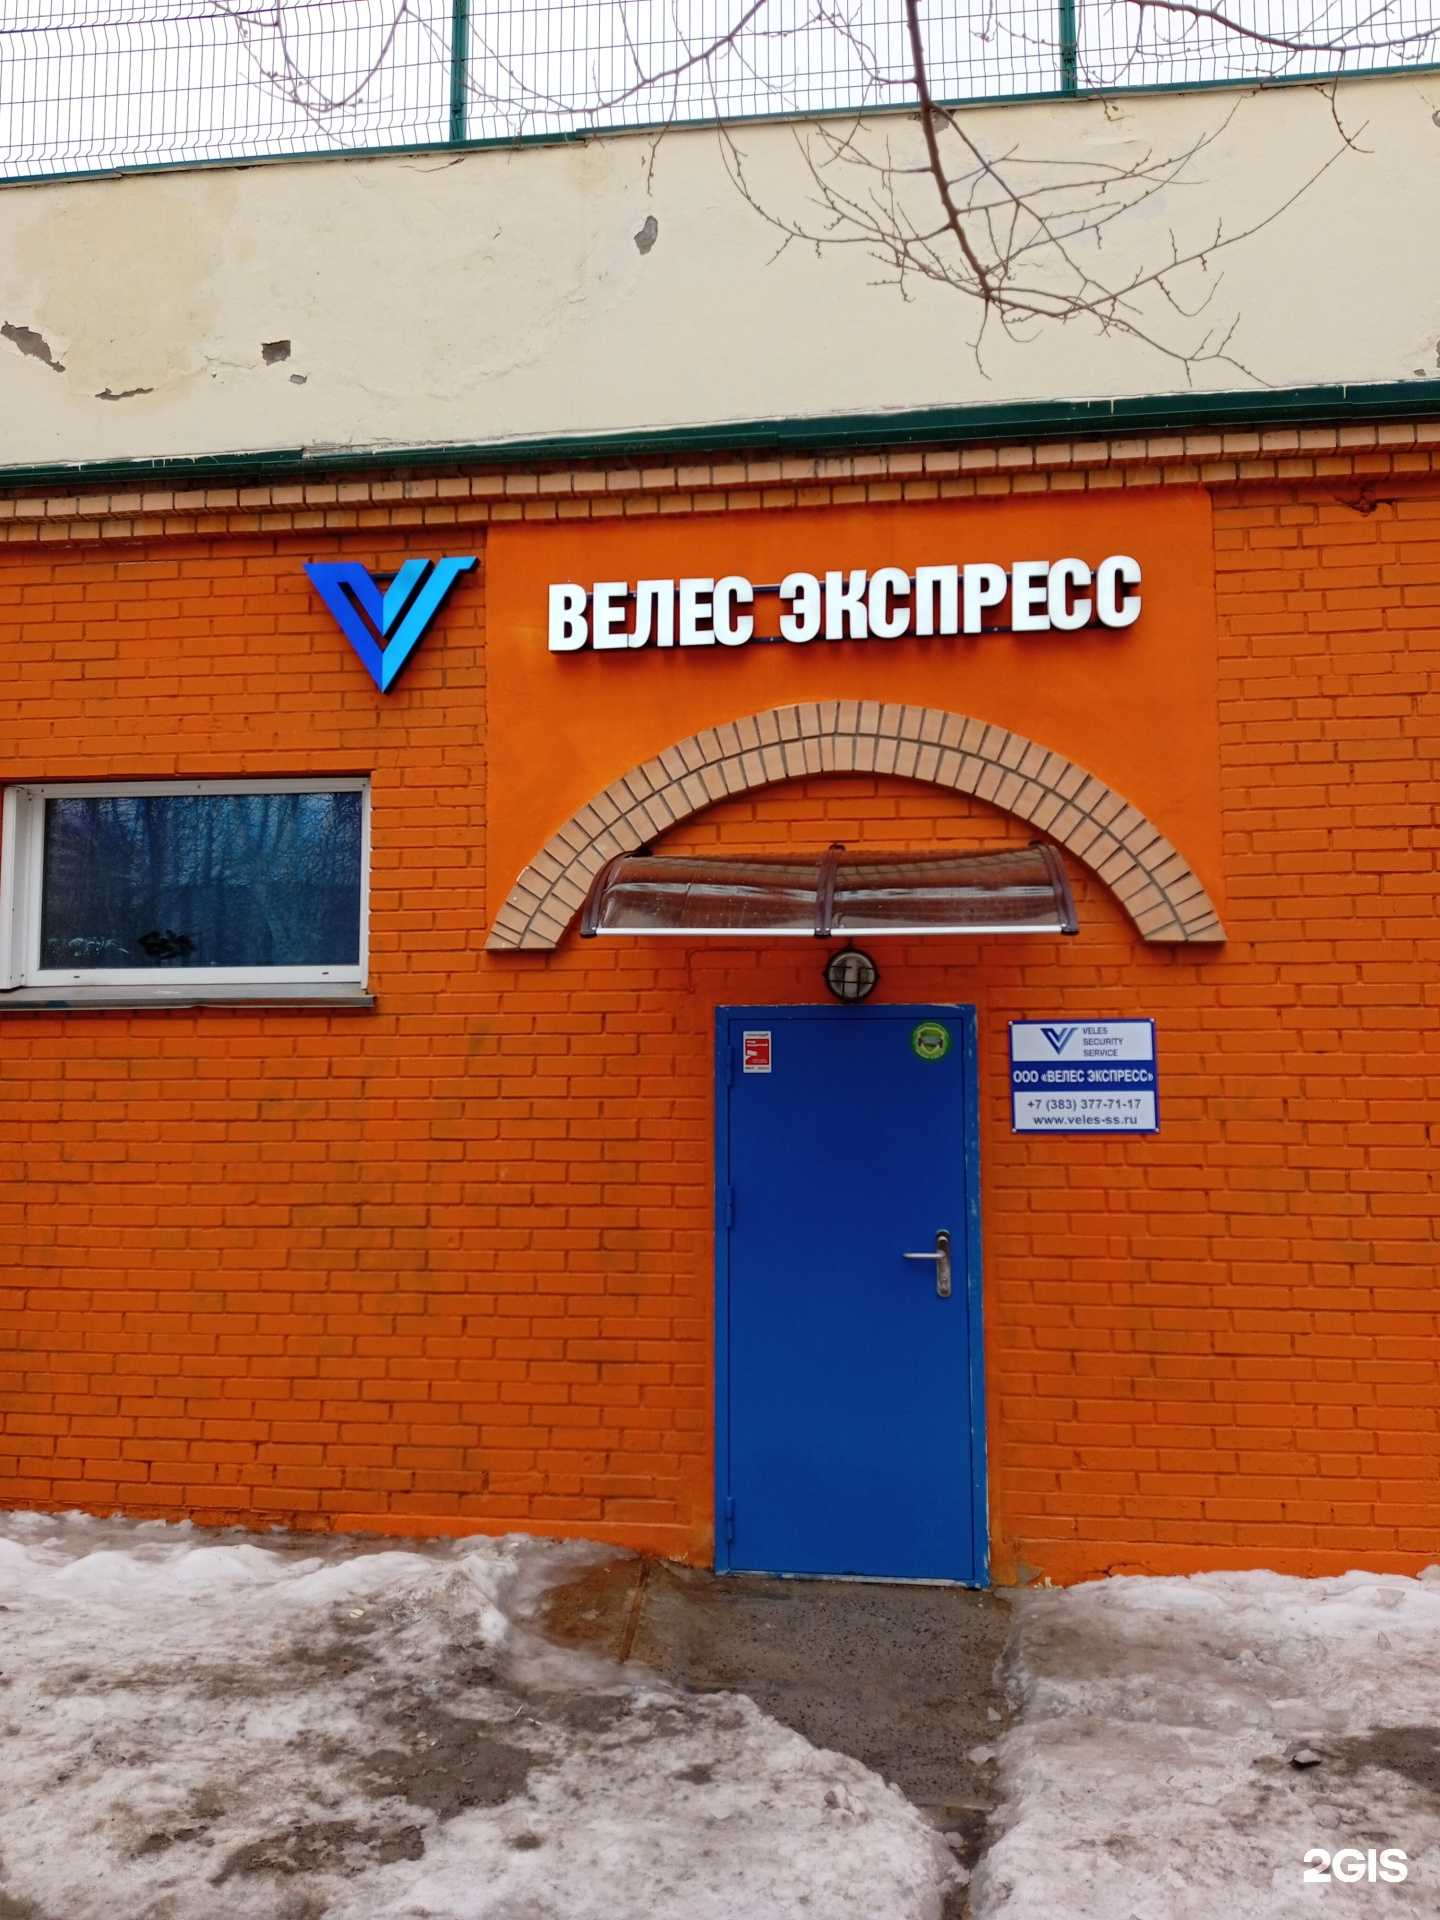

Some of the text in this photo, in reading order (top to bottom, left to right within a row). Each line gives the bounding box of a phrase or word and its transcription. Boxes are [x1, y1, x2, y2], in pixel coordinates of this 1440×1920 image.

[548, 554, 1143, 652] ВЕЛЕС ЭКСПРЕСС
[1082, 1027, 1108, 1035] VELES
[1083, 1038, 1124, 1046] SECURITY
[1083, 1049, 1118, 1057] SERVICE
[1013, 1068, 1153, 1083] ООО «ВЕЛЕС ЭКСПРЕСС»
[1027, 1099, 1141, 1111] +7 (383) 377-71-17
[1033, 1114, 1137, 1125] www.veles-ss.ru
